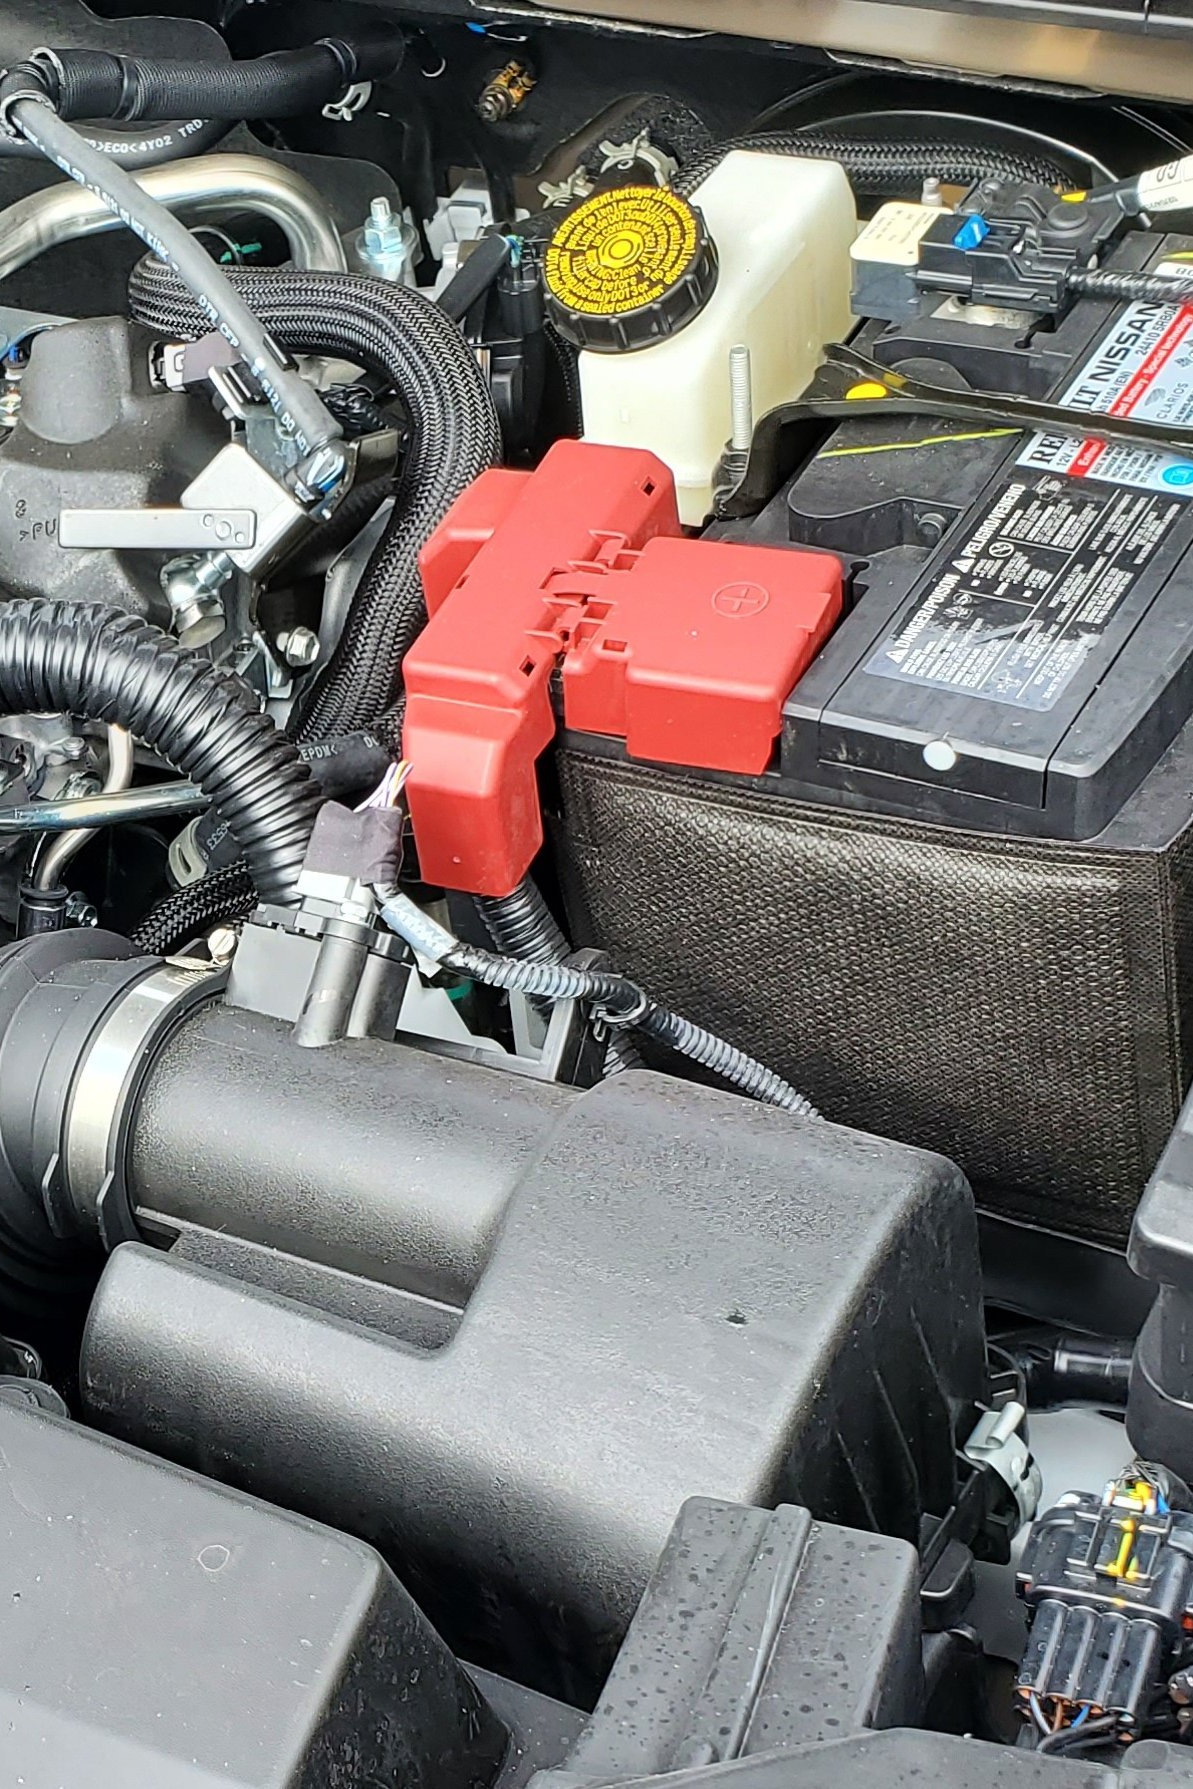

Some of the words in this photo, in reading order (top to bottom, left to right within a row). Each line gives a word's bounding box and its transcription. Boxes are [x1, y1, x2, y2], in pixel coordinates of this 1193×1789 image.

[1088, 299, 1165, 382] NISSAN
[1156, 382, 1189, 419] CLARIOS
[895, 573, 961, 651] DANGER/POISON
